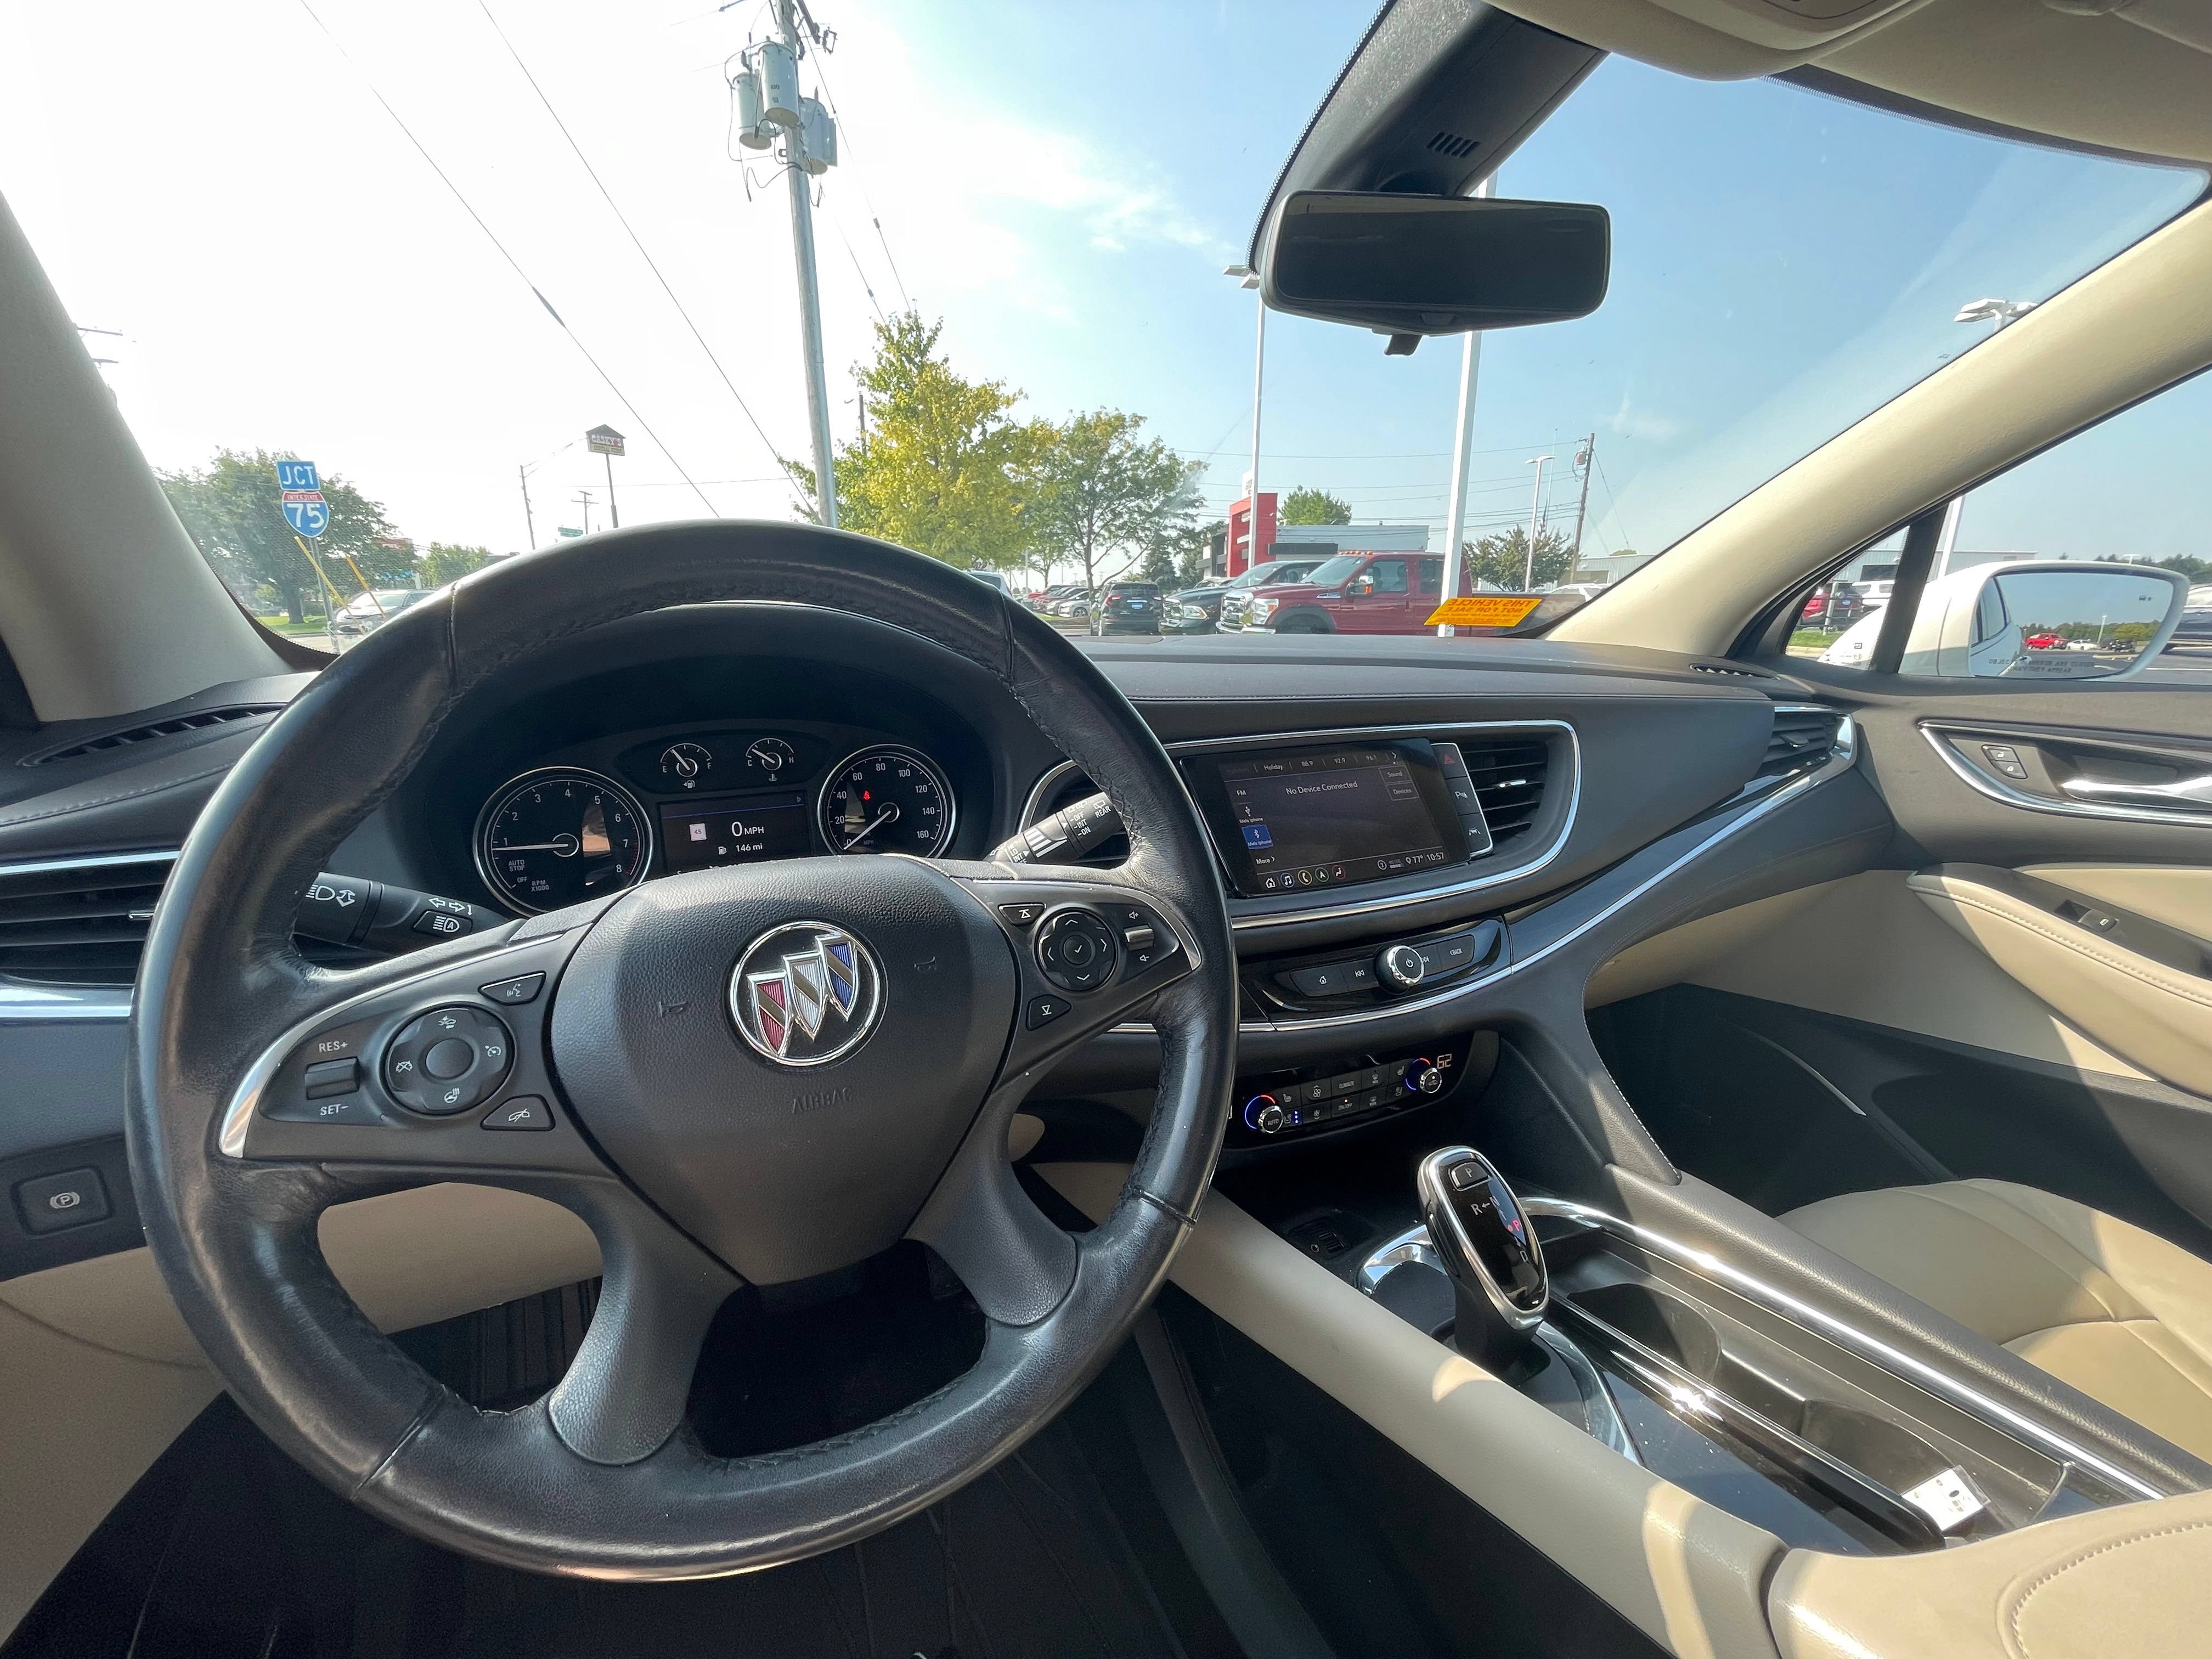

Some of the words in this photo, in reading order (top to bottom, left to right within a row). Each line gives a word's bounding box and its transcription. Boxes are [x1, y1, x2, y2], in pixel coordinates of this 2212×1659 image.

[592, 435, 622, 446] CASEY'S
[283, 466, 314, 485] JCT
[287, 503, 325, 528] 75
[876, 763, 886, 771] 80
[853, 772, 862, 781] 60
[898, 769, 911, 777] 100
[915, 785, 928, 793] 120
[1286, 787, 1297, 795] No
[1297, 786, 1321, 794] Device
[1322, 781, 1358, 791] Connected
[565, 789, 571, 797] 4
[837, 791, 847, 799] 40
[535, 794, 541, 803] 3
[595, 796, 601, 804] 5
[922, 806, 935, 815] 140
[1094, 806, 1111, 819] REAR
[512, 812, 518, 821] 2
[615, 813, 621, 822] 6
[834, 816, 845, 824] 20
[731, 821, 743, 837] 0
[744, 826, 764, 835] MPH
[917, 830, 929, 838] 160
[503, 838, 509, 847] 1
[623, 839, 629, 848] 7
[736, 844, 751, 853] 146
[753, 842, 763, 850] mi
[1013, 852, 1023, 862] INT
[1426, 852, 1444, 861] 10:57
[616, 865, 622, 873] 8
[318, 1040, 348, 1052] RES+
[1437, 1053, 1452, 1069] 62
[320, 1104, 349, 1116] SET-
[1466, 1167, 1472, 1178] P
[1471, 1203, 1483, 1215] R
[1489, 1195, 1501, 1207] N
[1513, 1220, 1520, 1231] P
[1520, 1251, 1529, 1262] D
